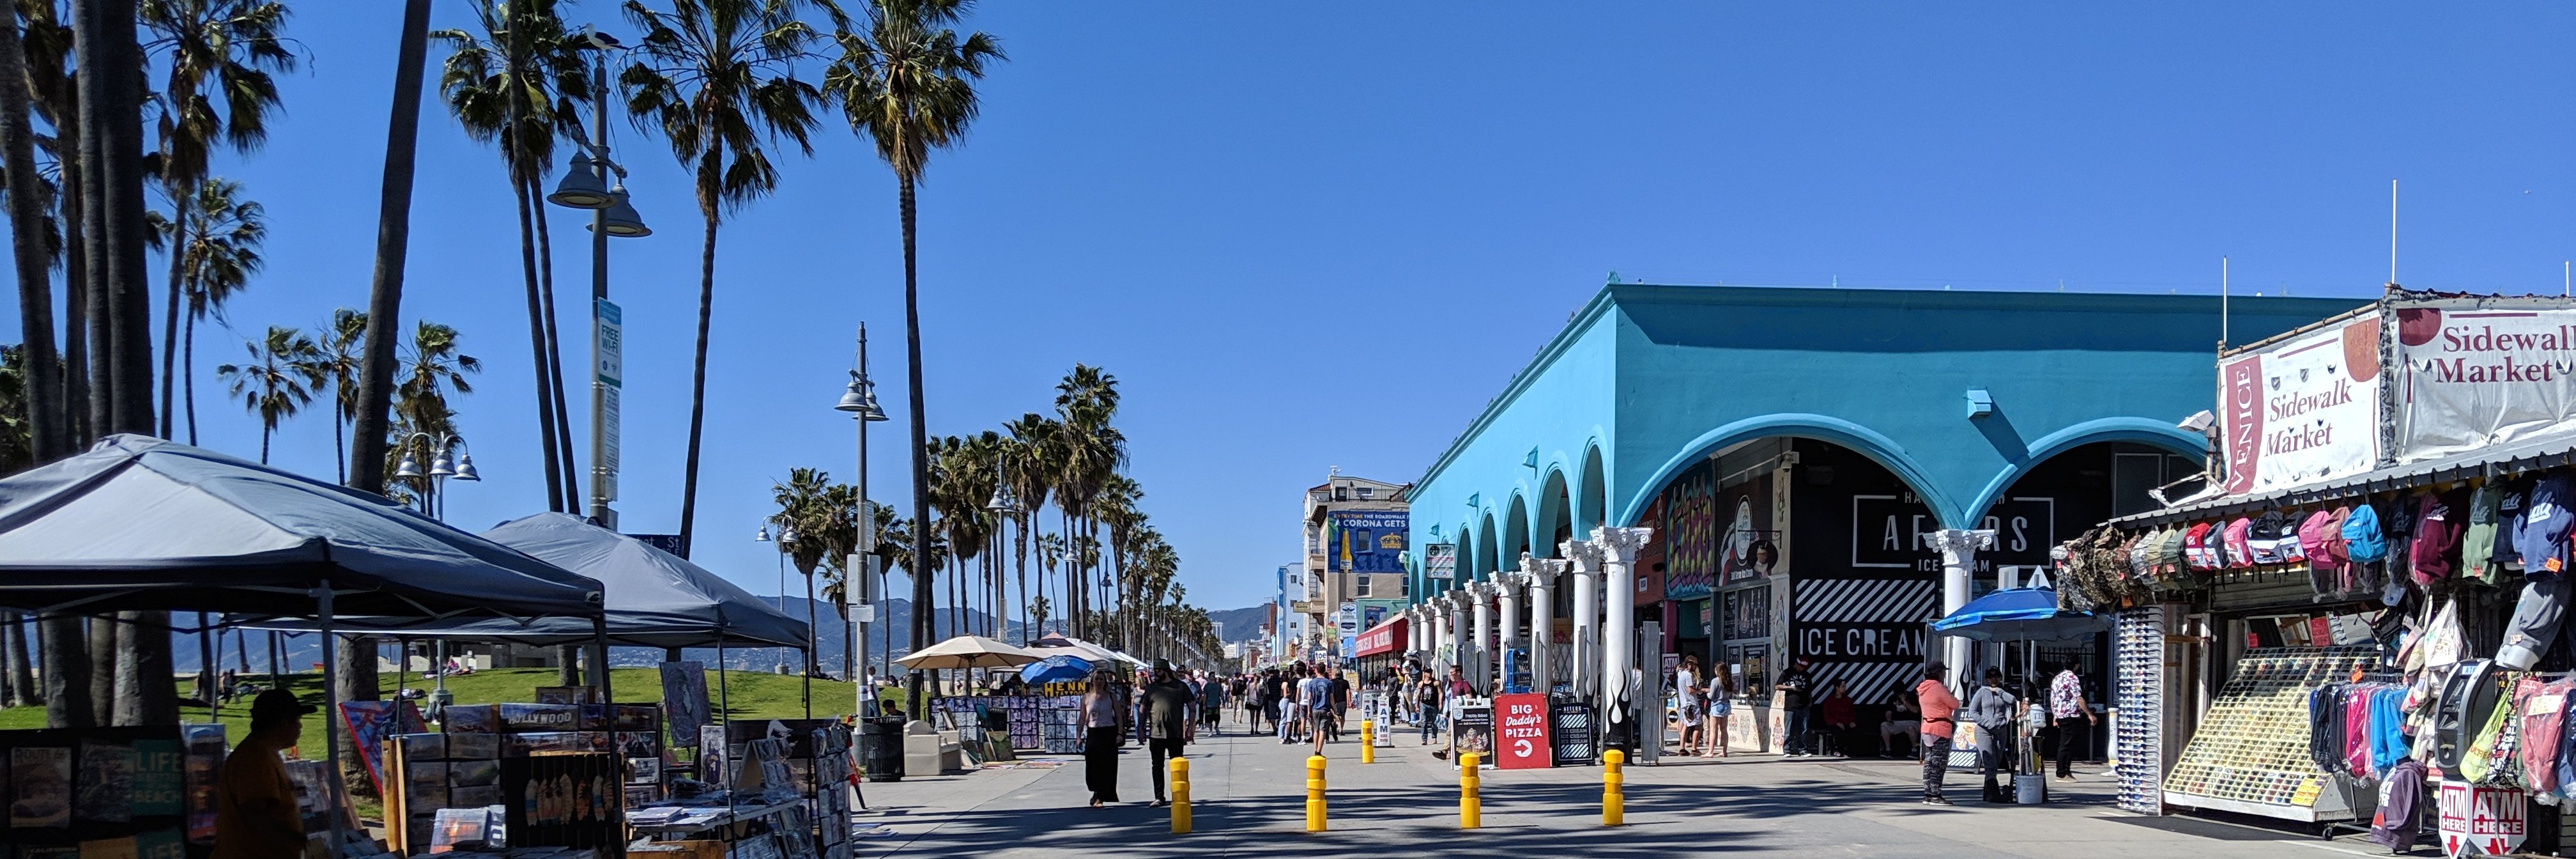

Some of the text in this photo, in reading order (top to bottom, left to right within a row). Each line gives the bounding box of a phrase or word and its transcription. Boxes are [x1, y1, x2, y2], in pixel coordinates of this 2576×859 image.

[602, 325, 618, 341] FREE
[602, 337, 618, 353] WI-FI
[2434, 356, 2553, 383] Market
[2269, 377, 2352, 422] Sidewalk
[2230, 366, 2252, 492] VENICE
[2264, 422, 2333, 457] Market
[1335, 518, 1406, 528] A CORONA GETS
[1883, 514, 2027, 552] AFRS
[667, 537, 679, 548] St
[1918, 559, 1938, 572] ICE
[1799, 629, 1926, 656] ICE CREAM
[1664, 658, 1678, 669] ATM
[1044, 681, 1086, 698] HENN
[1511, 704, 1533, 715] BIG
[508, 712, 571, 725] HOLLYWOOD
[1379, 708, 1388, 732] ATM
[1505, 714, 1542, 727] Daddy's
[1505, 727, 1543, 738] PIZZA
[135, 752, 182, 771] LIFE
[2441, 789, 2466, 819] ATM
[2473, 792, 2522, 820] ATM
[2442, 819, 2466, 831] HERE
[2474, 821, 2522, 833] HERE
